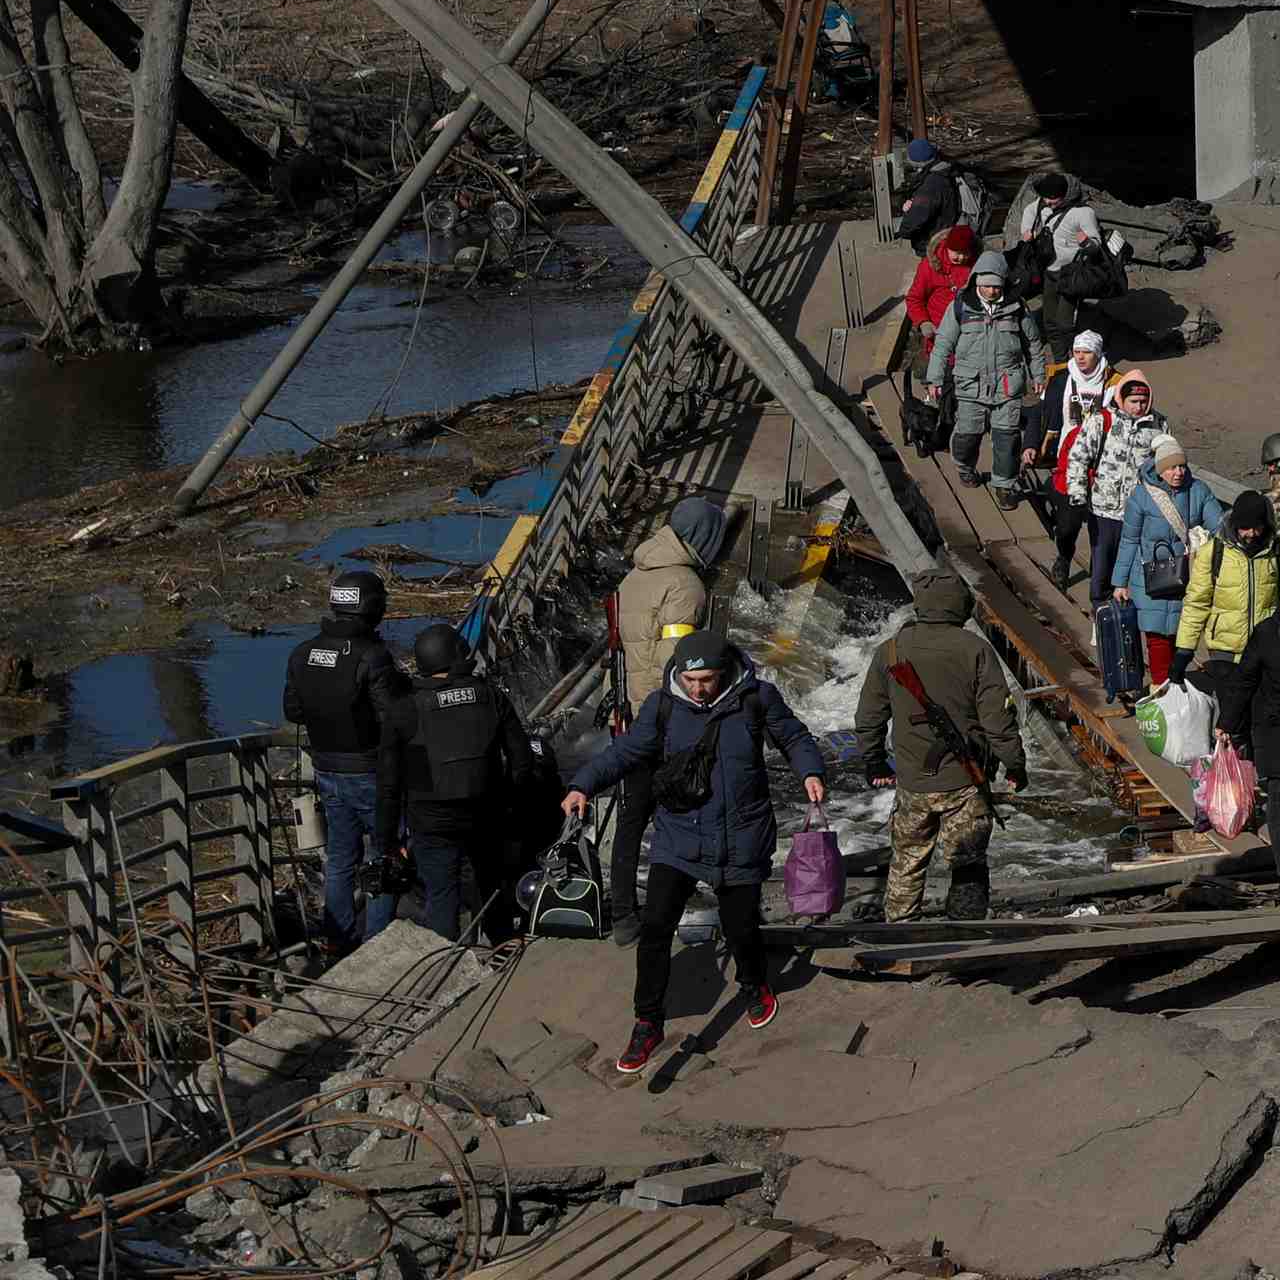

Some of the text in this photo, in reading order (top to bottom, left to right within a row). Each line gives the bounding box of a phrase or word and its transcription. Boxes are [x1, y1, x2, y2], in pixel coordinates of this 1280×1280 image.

[330, 590, 357, 602] PRESS
[310, 652, 337, 665] PRESS
[440, 689, 474, 705] PRESS
